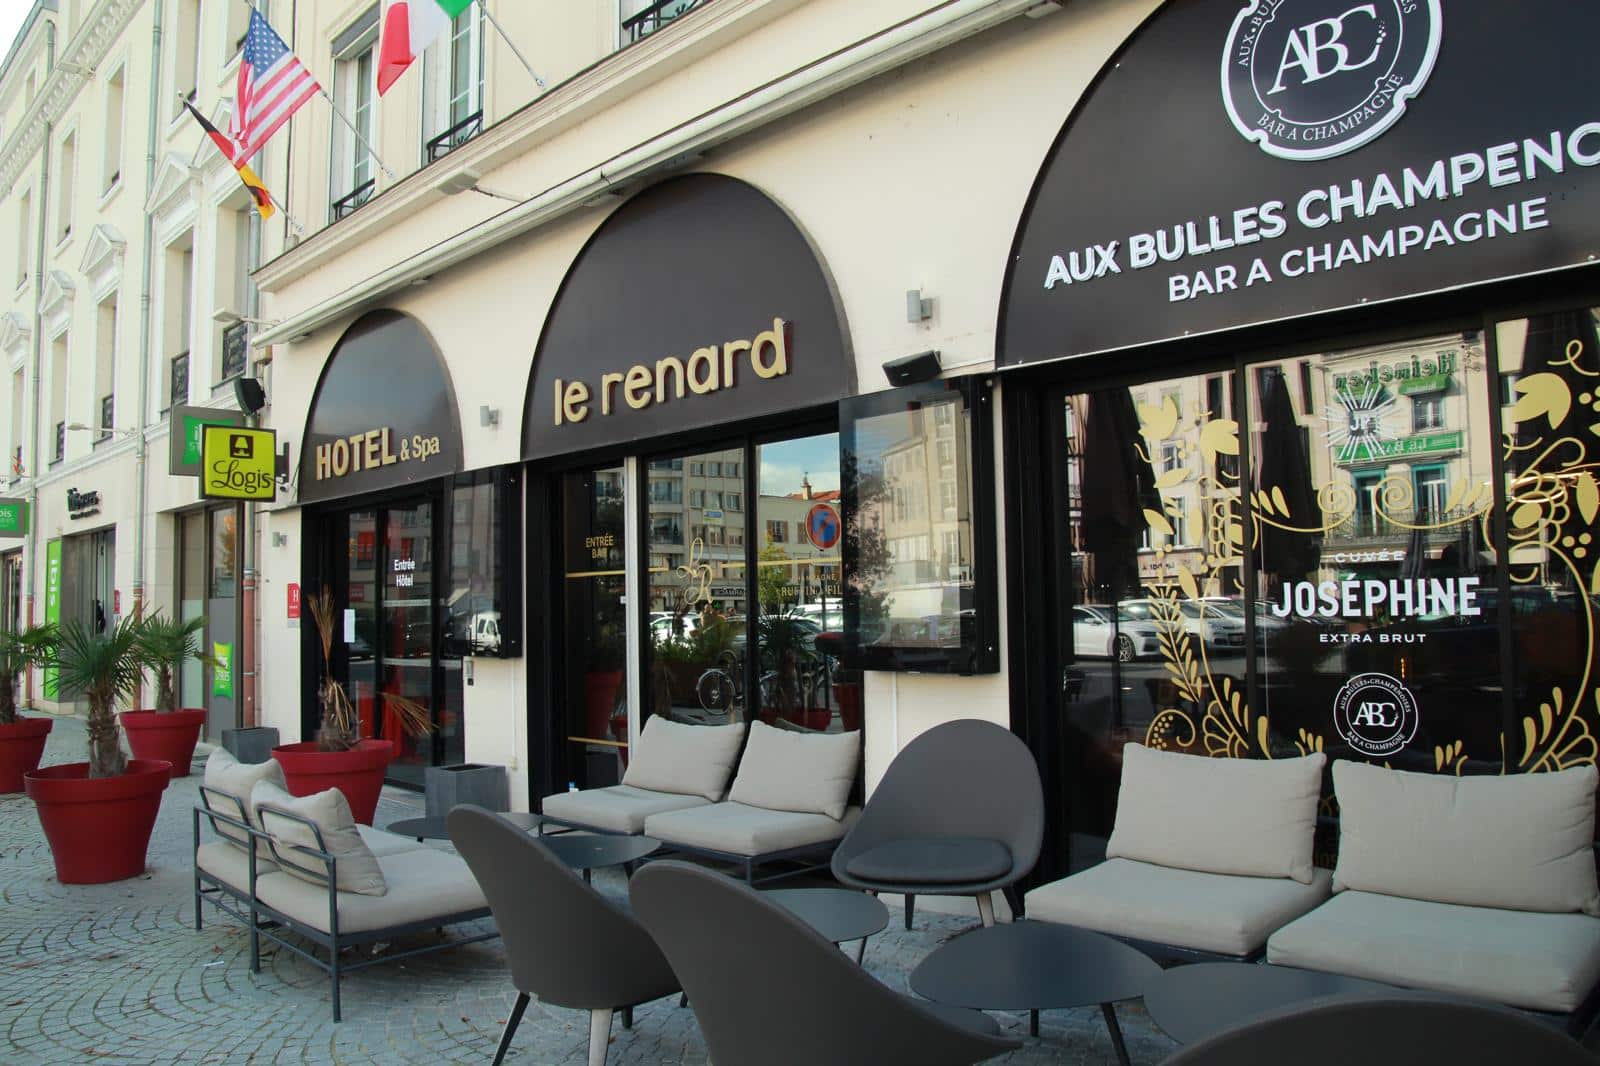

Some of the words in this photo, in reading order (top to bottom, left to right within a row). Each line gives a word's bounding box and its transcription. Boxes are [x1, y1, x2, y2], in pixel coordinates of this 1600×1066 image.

[1266, 4, 1386, 95] ABC
[1257, 113, 1285, 139] BAR
[1289, 130, 1298, 141] A
[1302, 74, 1404, 141] CHAMPAGNE
[1044, 240, 1121, 289] AUX
[1128, 200, 1288, 269] BULLES
[1168, 264, 1239, 302] BAR
[1245, 258, 1273, 287] A
[1280, 197, 1550, 278] CHAMPAGNE
[554, 378, 590, 426] le
[602, 317, 788, 415] renard
[316, 426, 397, 480] HOTEL
[400, 438, 411, 461] &
[412, 434, 440, 462] Spa
[211, 459, 272, 494] Logis
[585, 532, 615, 548] ENTRÉE
[1335, 547, 1407, 564] CUVÉE
[394, 557, 416, 571] Entrée
[396, 573, 414, 587] Hôtel
[1271, 573, 1481, 618] JOSÉPHINE
[1319, 633, 1373, 643] EXTRA
[1379, 633, 1427, 643] BRUT
[1352, 701, 1399, 728] ABC
[1364, 733, 1406, 750] CHAMPAGNE
